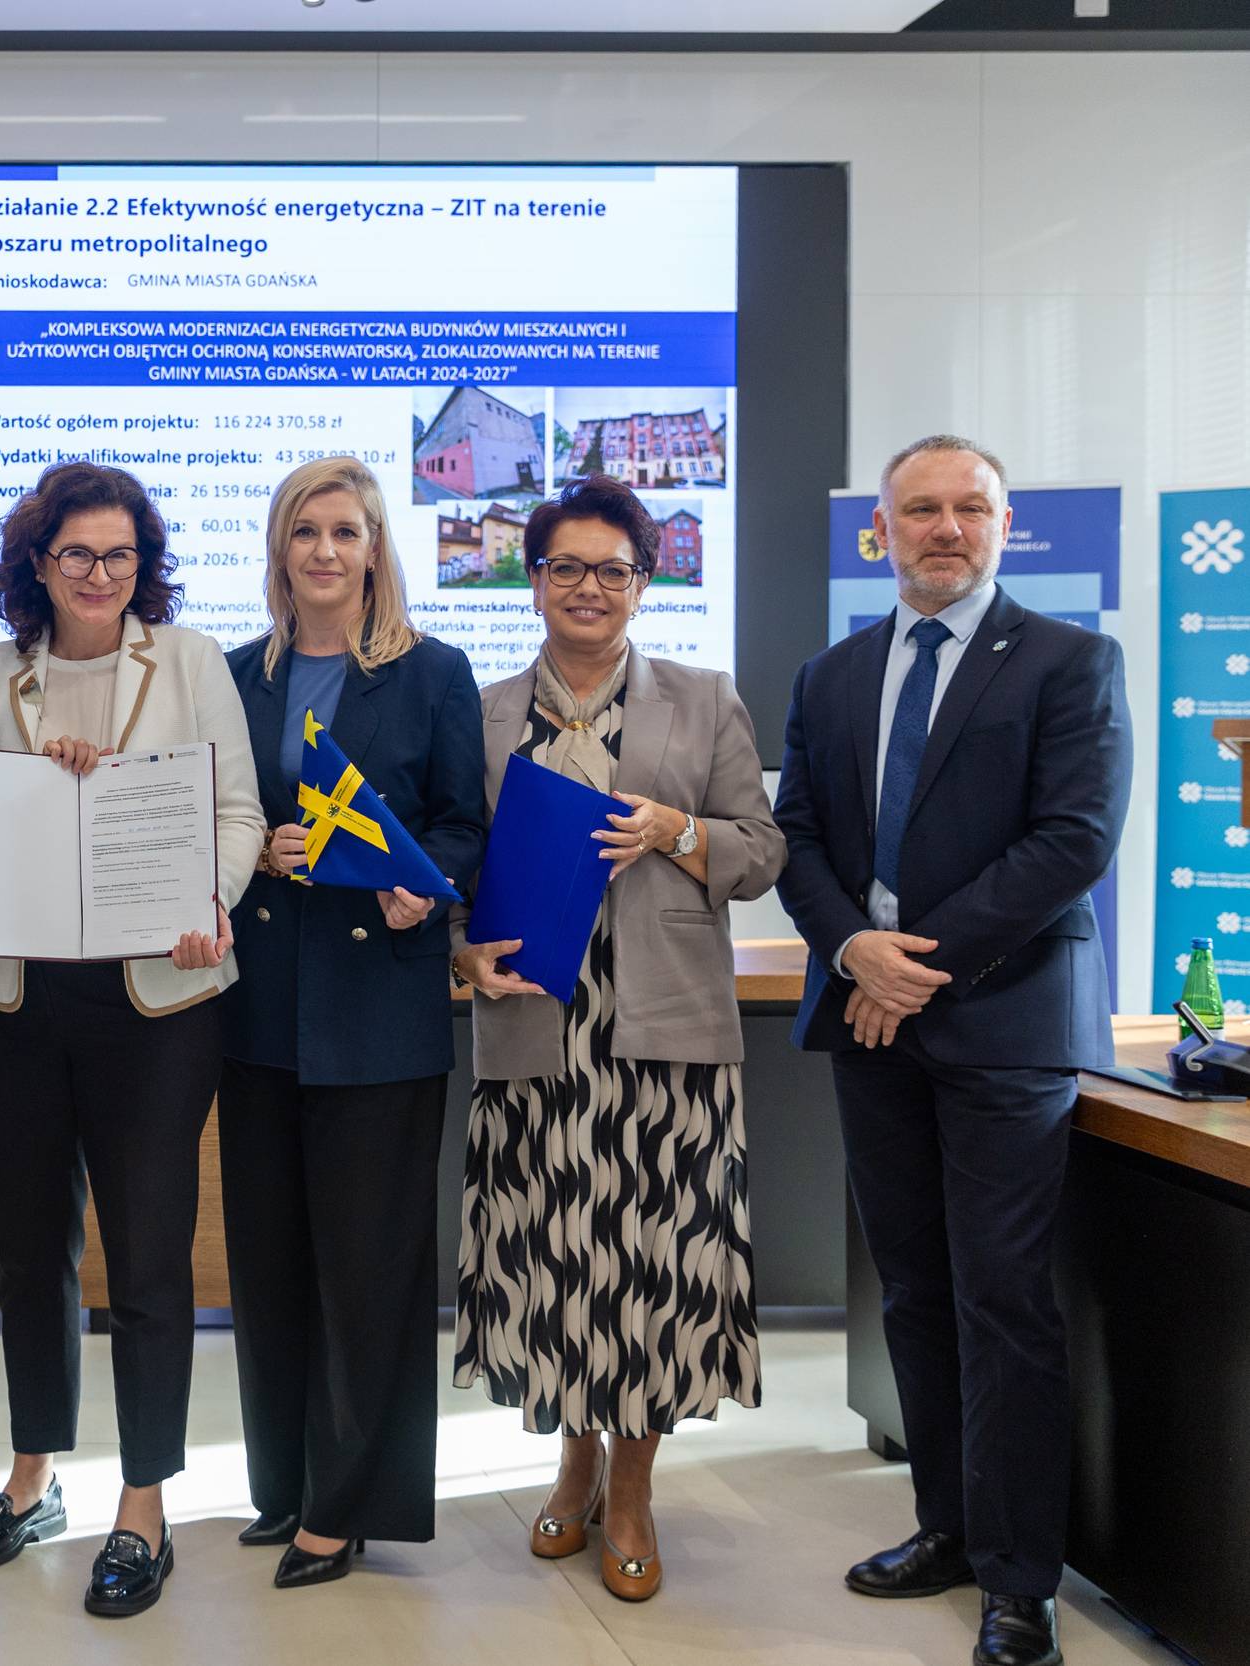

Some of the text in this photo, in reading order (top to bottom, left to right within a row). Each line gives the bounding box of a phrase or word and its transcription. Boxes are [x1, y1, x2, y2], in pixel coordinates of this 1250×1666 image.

[86, 198, 119, 216] 2.2
[127, 196, 267, 221] Efektywność
[275, 200, 424, 222] energetyczna
[451, 198, 486, 216] ZIT
[495, 203, 519, 216] na
[529, 198, 607, 216] terenie
[71, 234, 268, 257] metropolitalnego
[128, 274, 181, 287] GMINA
[186, 274, 241, 287] MIASTA
[246, 270, 317, 287] GDAŃSKA
[40, 320, 627, 338] „KOMPLEKSOWA MODERNIZACJA ENERGETYCZNA BUDYNKÓW MIESZKALNYCH I
[7, 341, 660, 361] UŻYTKOWYCH OBJĘTYCH OCHRONĄ KONSERWATORSKĄ, ZLOKALIZOWANYCH NA TERENIE
[149, 366, 201, 380] GMINY
[205, 366, 261, 380] MIASTA
[265, 363, 338, 380] GDAŃSKA
[351, 367, 368, 380] W
[372, 367, 427, 380] LATACH
[57, 414, 118, 432] ogółem
[124, 414, 199, 432] projektu:
[214, 416, 240, 428] 116
[245, 416, 272, 428] 224
[277, 416, 326, 430] 370,58
[331, 416, 342, 428] zł
[57, 449, 181, 463] kwalifikowalne
[187, 449, 262, 466] projektu:
[275, 451, 293, 463] 43
[384, 451, 395, 463] zł
[190, 485, 208, 498] 26
[214, 485, 239, 498] 159
[201, 519, 241, 533] 60,01
[247, 519, 259, 532] %
[203, 554, 238, 566] 2026
[182, 601, 262, 614] fektywności
[454, 601, 535, 615] mieszkalnyc
[640, 602, 708, 615] publicznej
[419, 619, 475, 632] Gdańska
[490, 622, 541, 633] poprzez
[479, 641, 524, 653] energii
